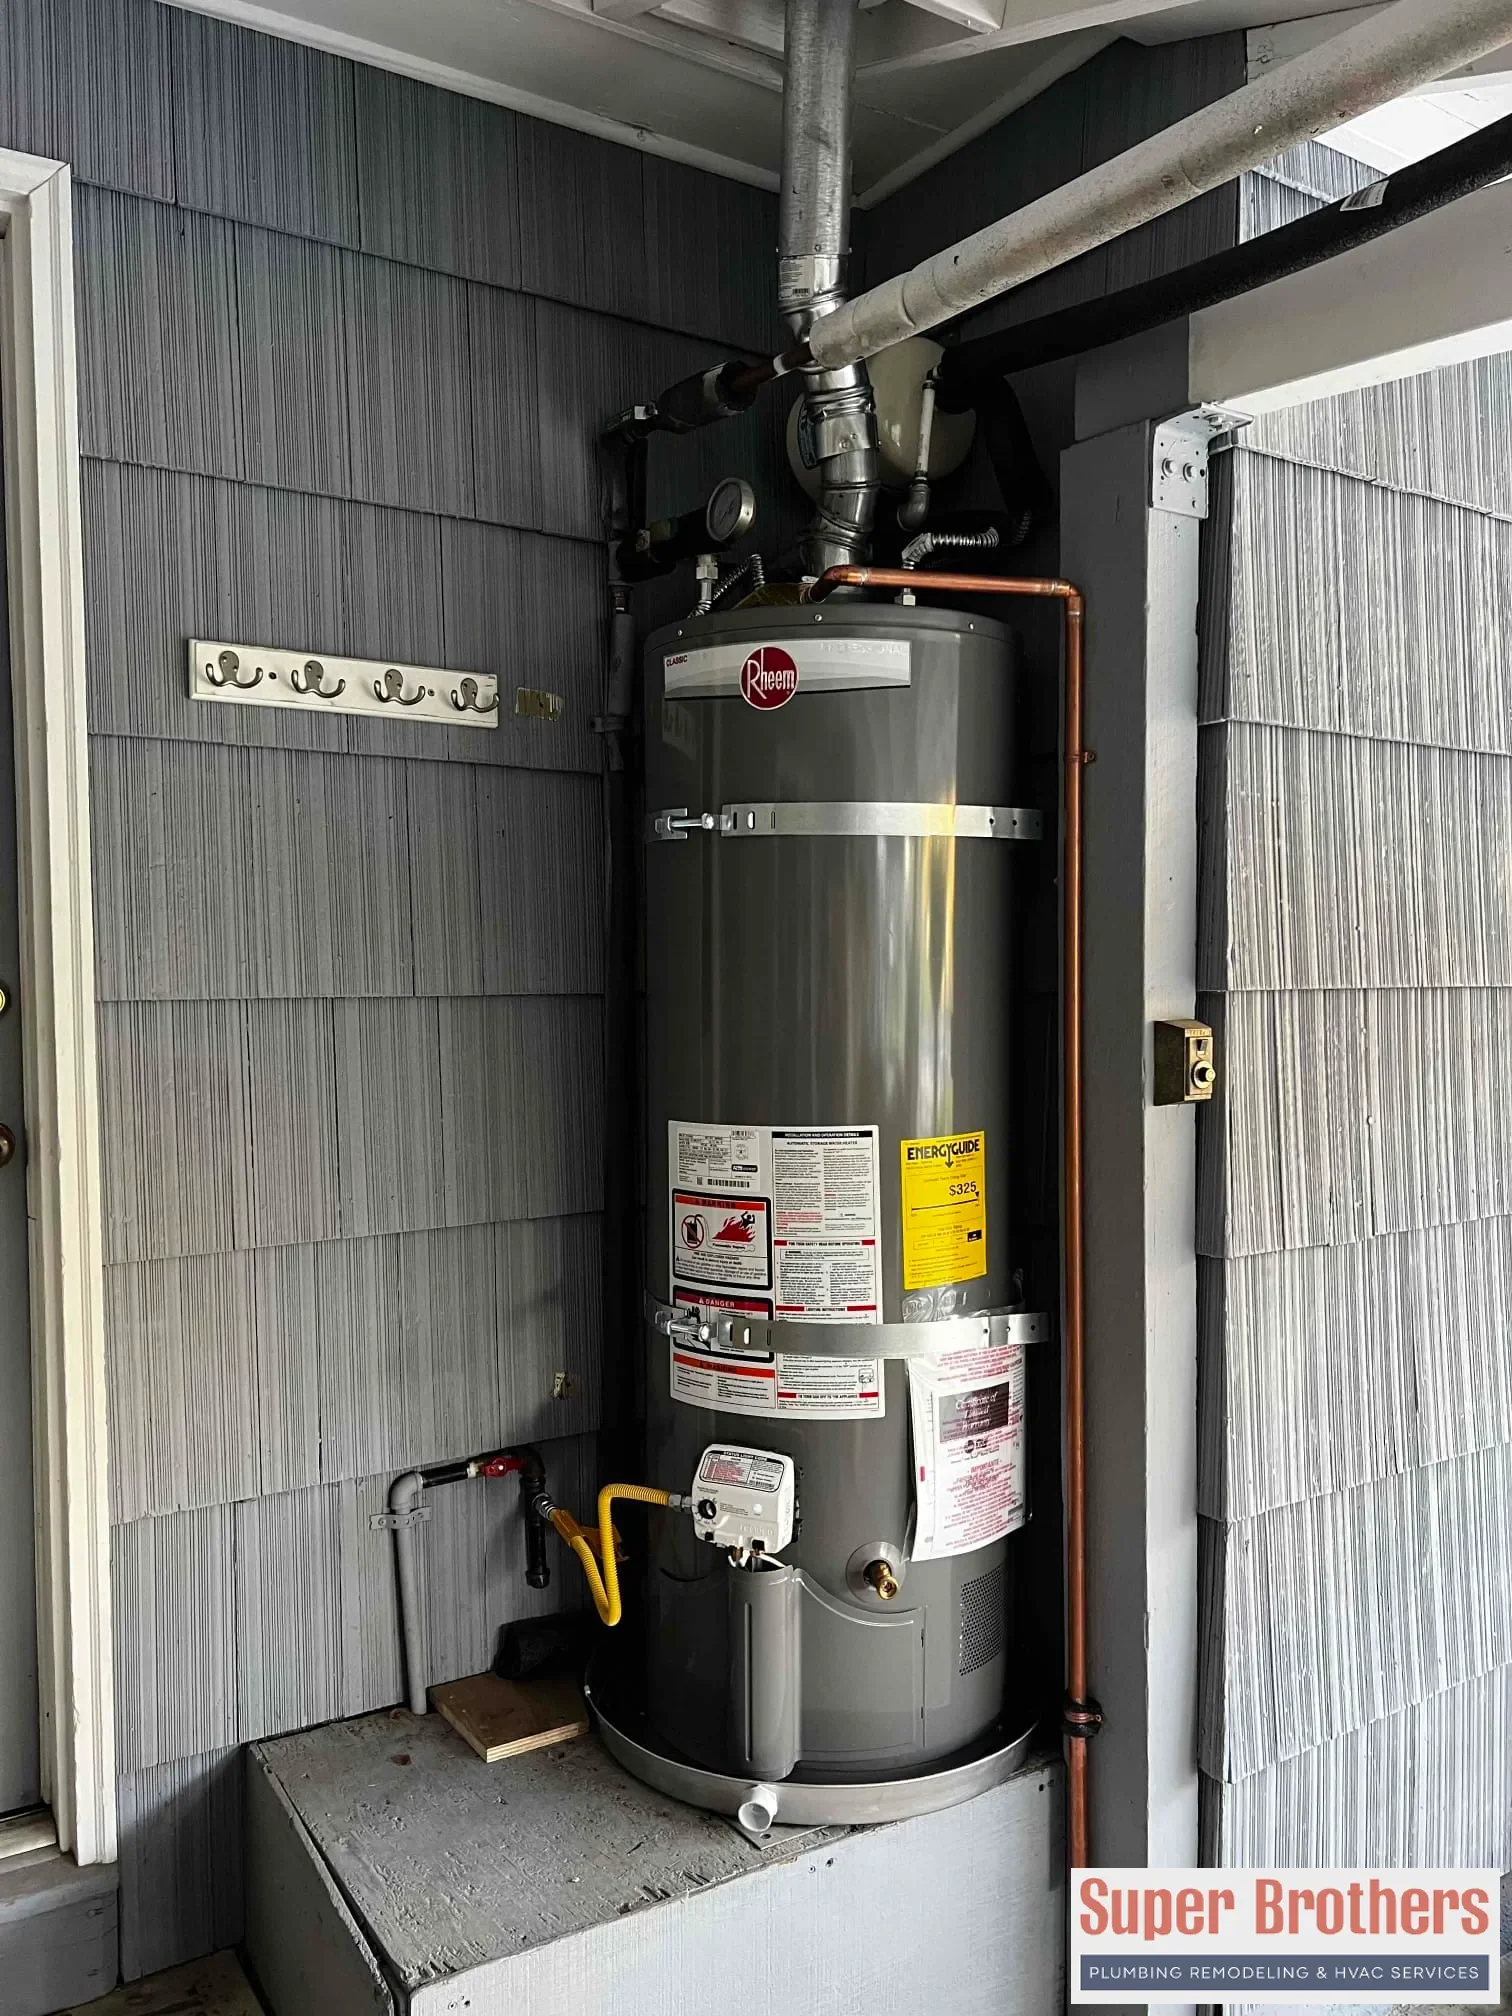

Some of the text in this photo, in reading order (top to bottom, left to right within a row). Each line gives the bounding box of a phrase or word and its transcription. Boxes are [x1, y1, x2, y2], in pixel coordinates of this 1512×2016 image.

[665, 655, 688, 667] CLASSIC
[746, 648, 795, 700] Rheem
[906, 1139, 980, 1162] ENERGYGUIDE
[705, 1298, 735, 1308] DANGER
